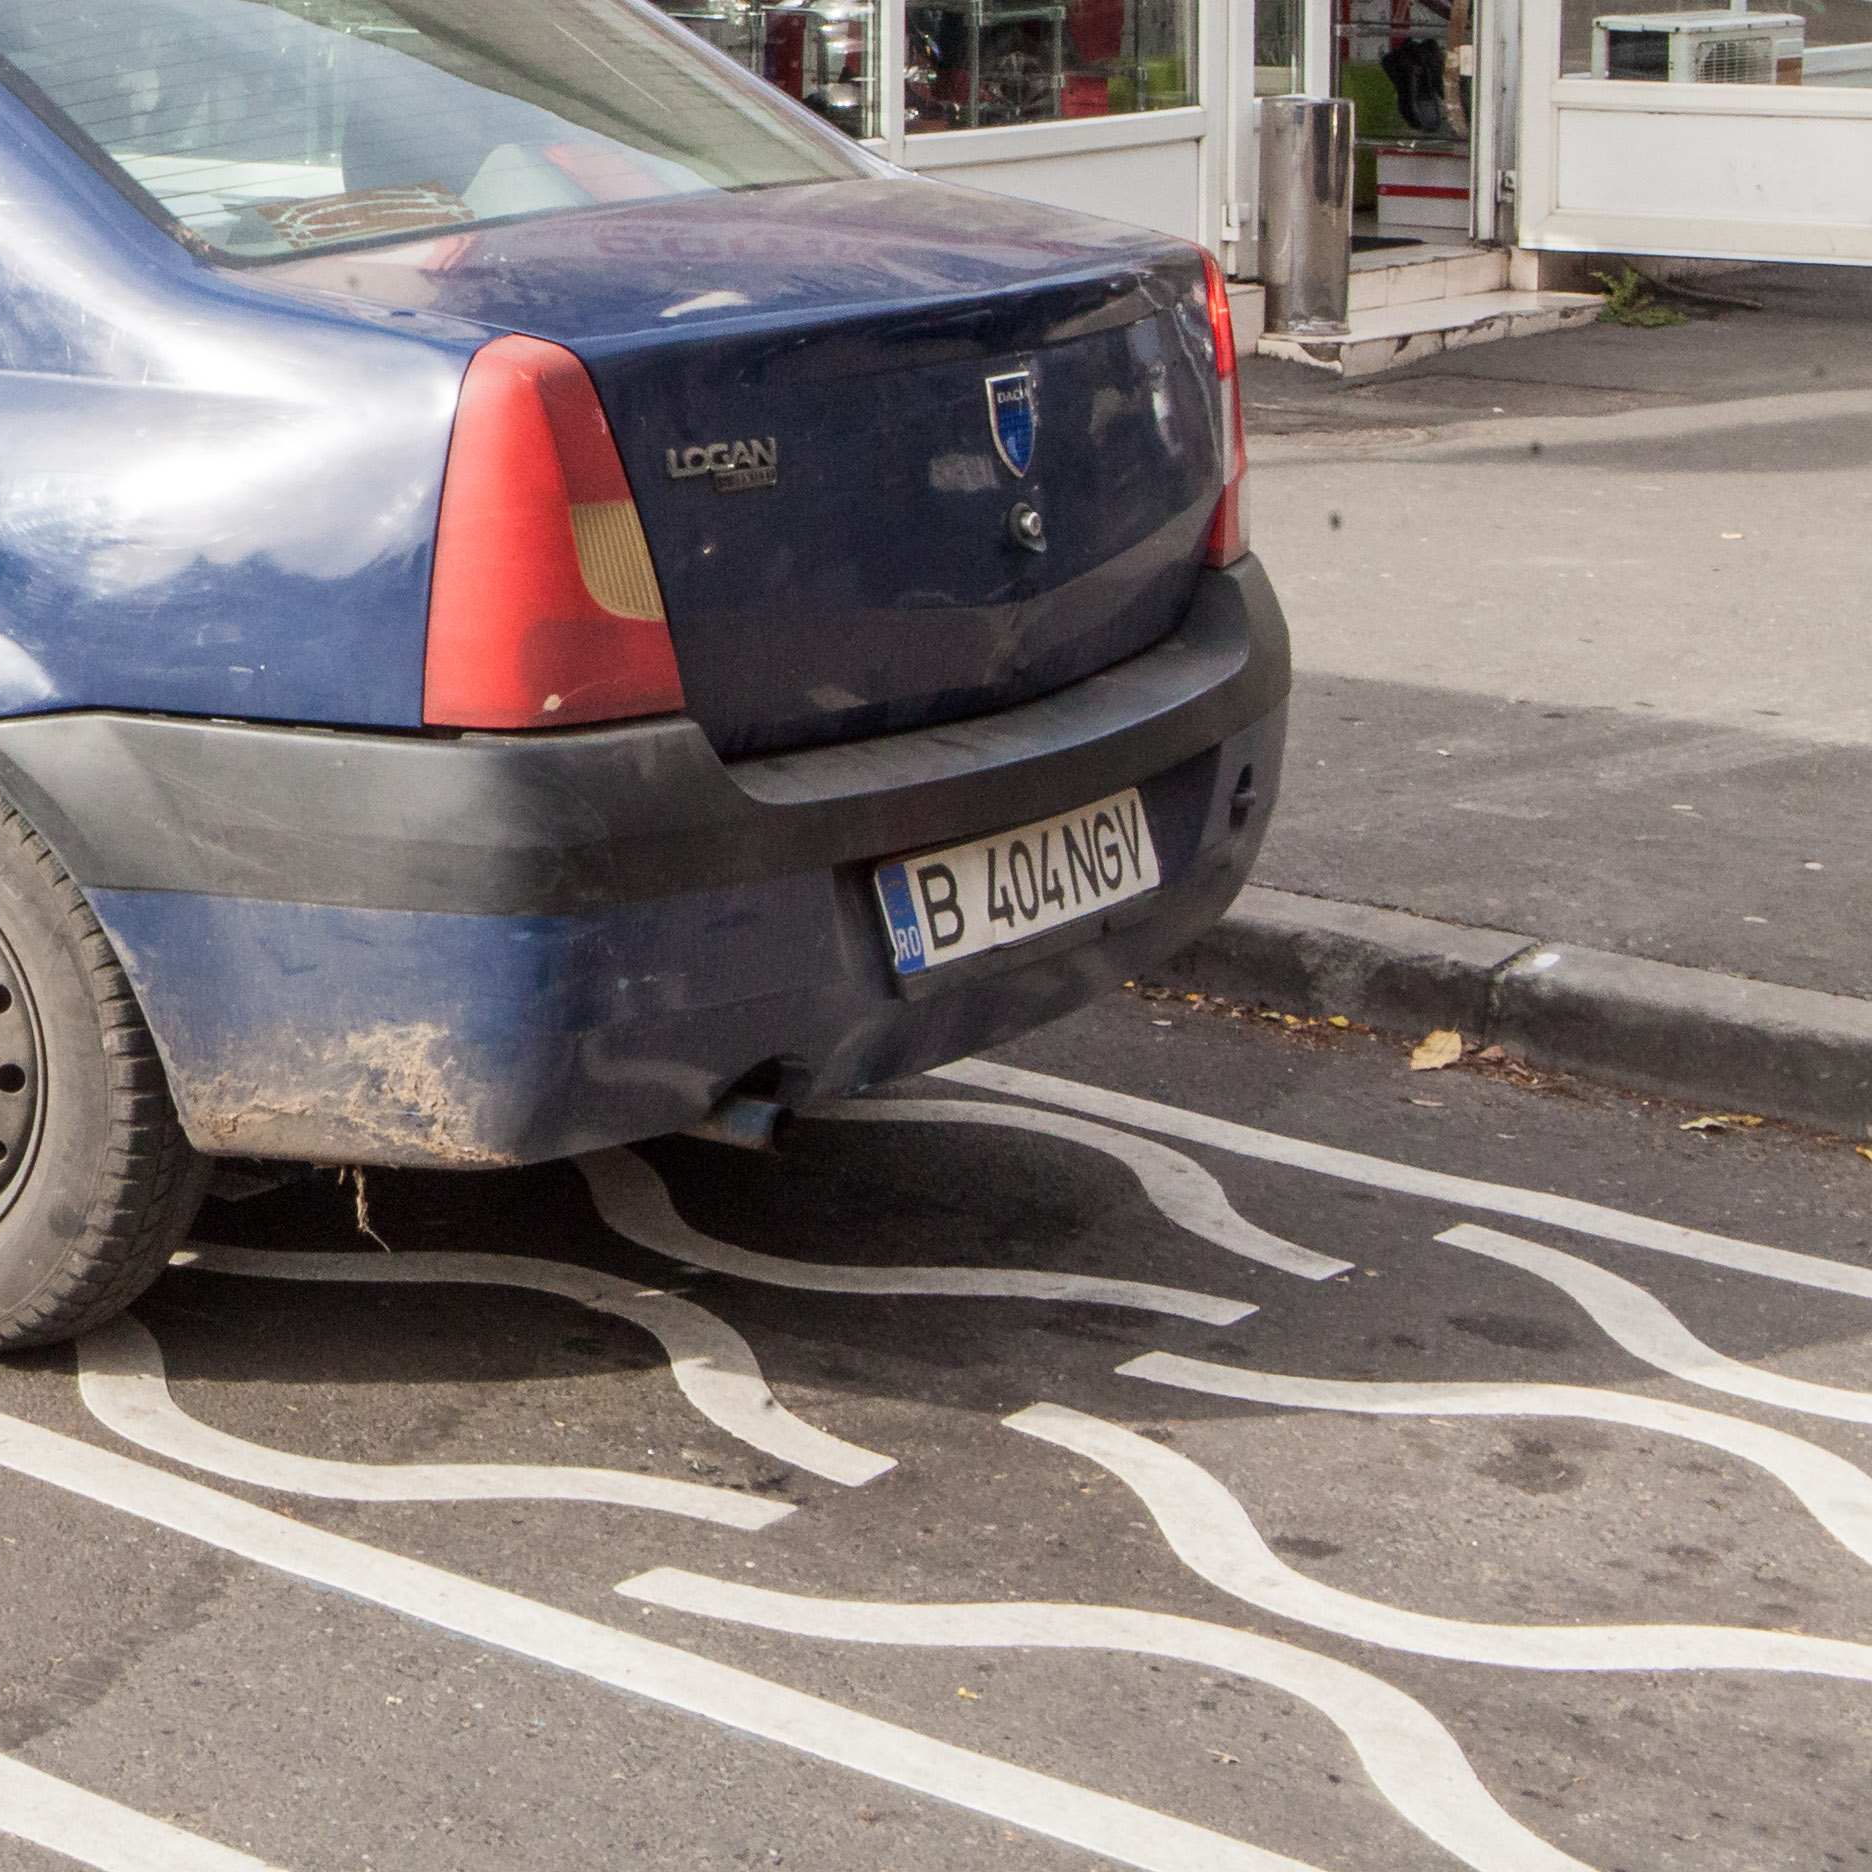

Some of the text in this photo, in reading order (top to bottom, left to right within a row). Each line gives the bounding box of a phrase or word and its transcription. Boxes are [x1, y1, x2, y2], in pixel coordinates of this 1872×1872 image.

[665, 436, 778, 479] LOGAN
[916, 863, 965, 951] B
[897, 926, 922, 961] RO
